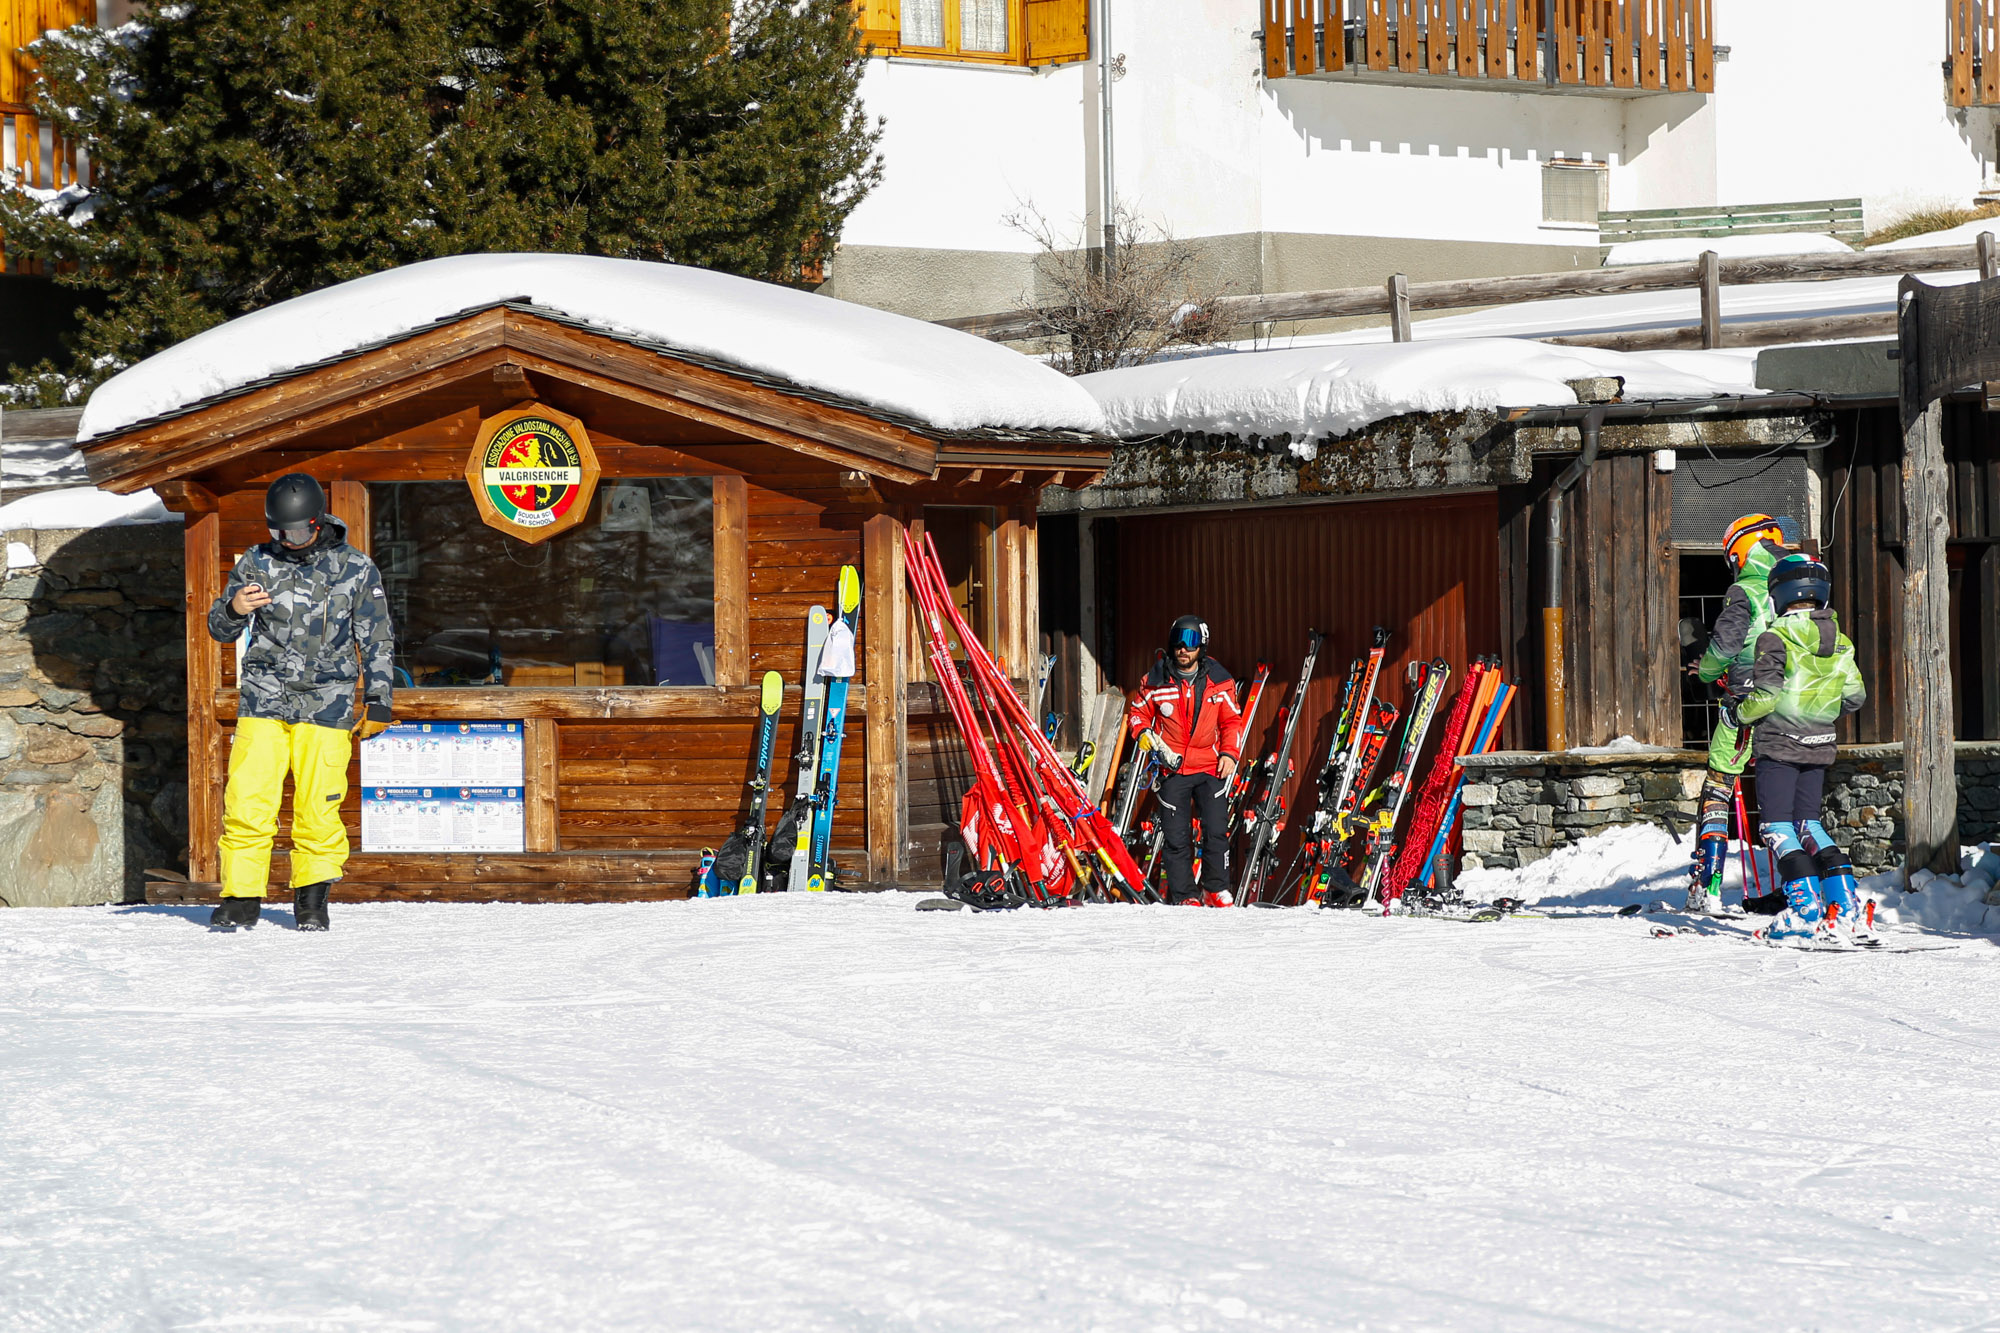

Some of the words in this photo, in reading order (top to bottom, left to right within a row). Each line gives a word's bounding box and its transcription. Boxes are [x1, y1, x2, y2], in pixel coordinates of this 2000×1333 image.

[514, 420, 550, 436] VALDOSTANA
[549, 427, 571, 450] MAESTRI
[487, 429, 516, 467] ASSOCIAZIONE
[567, 446, 576, 456] DI
[569, 454, 580, 466] SCI
[499, 471, 569, 481] VALGRISENCHE
[517, 510, 541, 520] SCUOLA
[528, 518, 553, 526] SCHOOL
[1352, 662, 1376, 732] BLIZZARD
[1409, 672, 1440, 746] FISCHER
[759, 717, 773, 770] DYNAFIT
[814, 834, 825, 864] SUMMITS
[809, 878, 821, 888] 84
